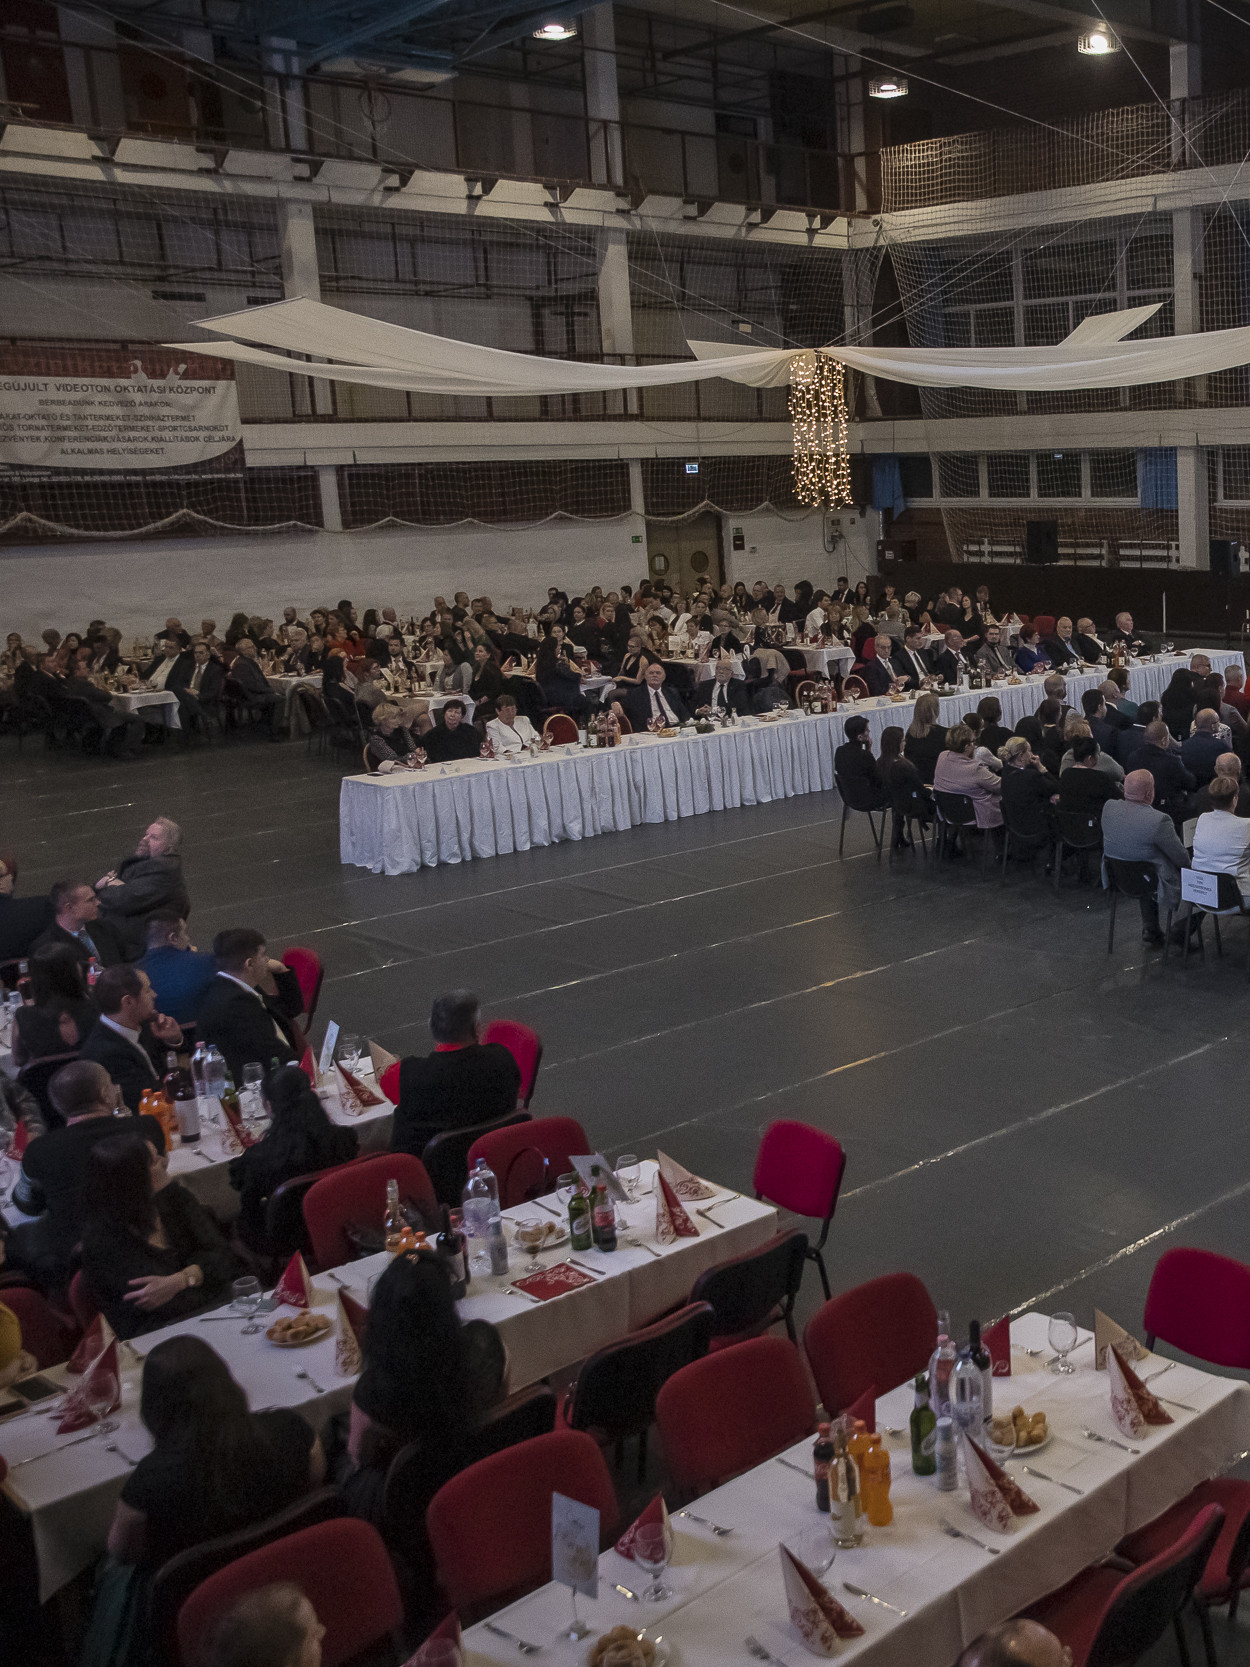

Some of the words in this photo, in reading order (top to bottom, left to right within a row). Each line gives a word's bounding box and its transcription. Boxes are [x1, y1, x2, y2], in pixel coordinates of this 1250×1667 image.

[54, 382, 112, 393] VIDEOTON
[114, 383, 166, 394] OKTATÁSI
[168, 384, 217, 395] KÖZPONT
